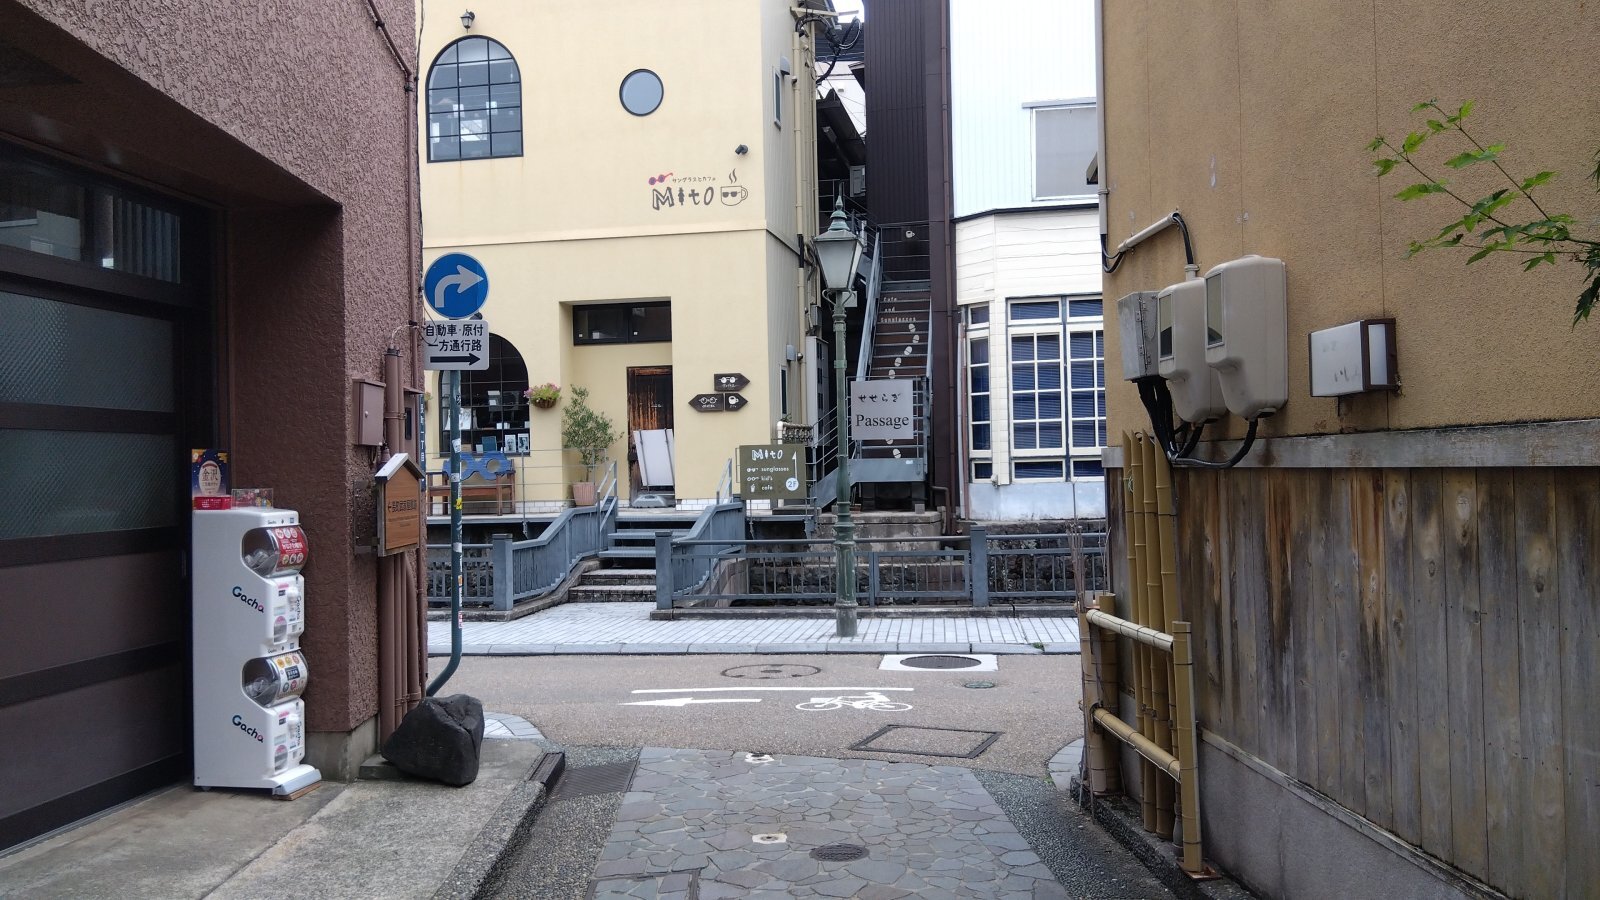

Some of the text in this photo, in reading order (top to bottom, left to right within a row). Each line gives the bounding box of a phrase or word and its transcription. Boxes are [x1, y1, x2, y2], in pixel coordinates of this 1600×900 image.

[425, 323, 484, 337] 自動車・原付
[427, 339, 482, 352] 一方通行路
[858, 393, 901, 403] せせらぎ
[855, 414, 910, 430] Passage
[787, 480, 797, 488] 2F
[232, 586, 265, 614] Gacha
[232, 714, 264, 743] Gacha
